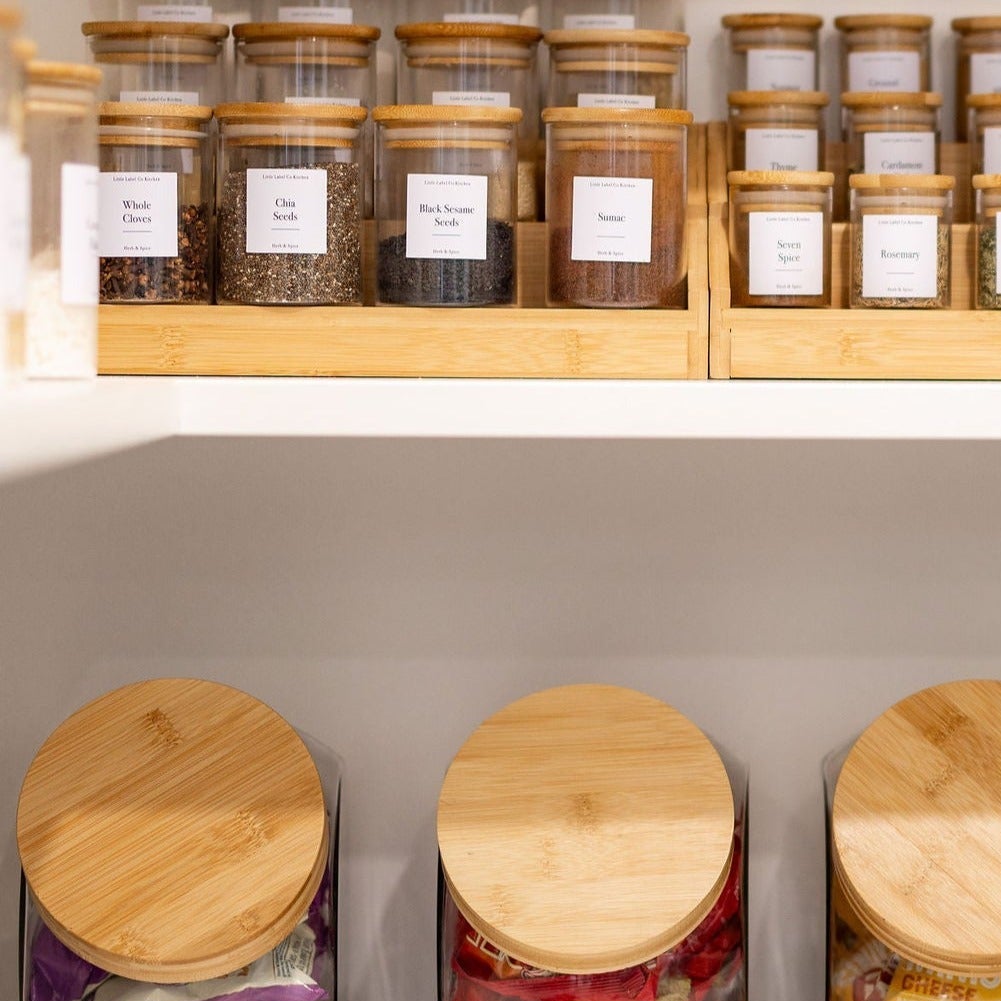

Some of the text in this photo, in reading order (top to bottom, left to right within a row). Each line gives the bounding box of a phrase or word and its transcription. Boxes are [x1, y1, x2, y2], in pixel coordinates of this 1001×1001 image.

[122, 200, 152, 210] Whole
[275, 198, 296, 208] Chia
[419, 203, 475, 214] Black Sesame
[122, 214, 152, 224] Cloves
[272, 212, 298, 221] Seeds
[598, 212, 626, 222] Sumac
[434, 217, 459, 228] Seeds
[777, 240, 801, 250] Seven
[778, 253, 800, 264] Spice
[880, 249, 920, 262] Rosemary
